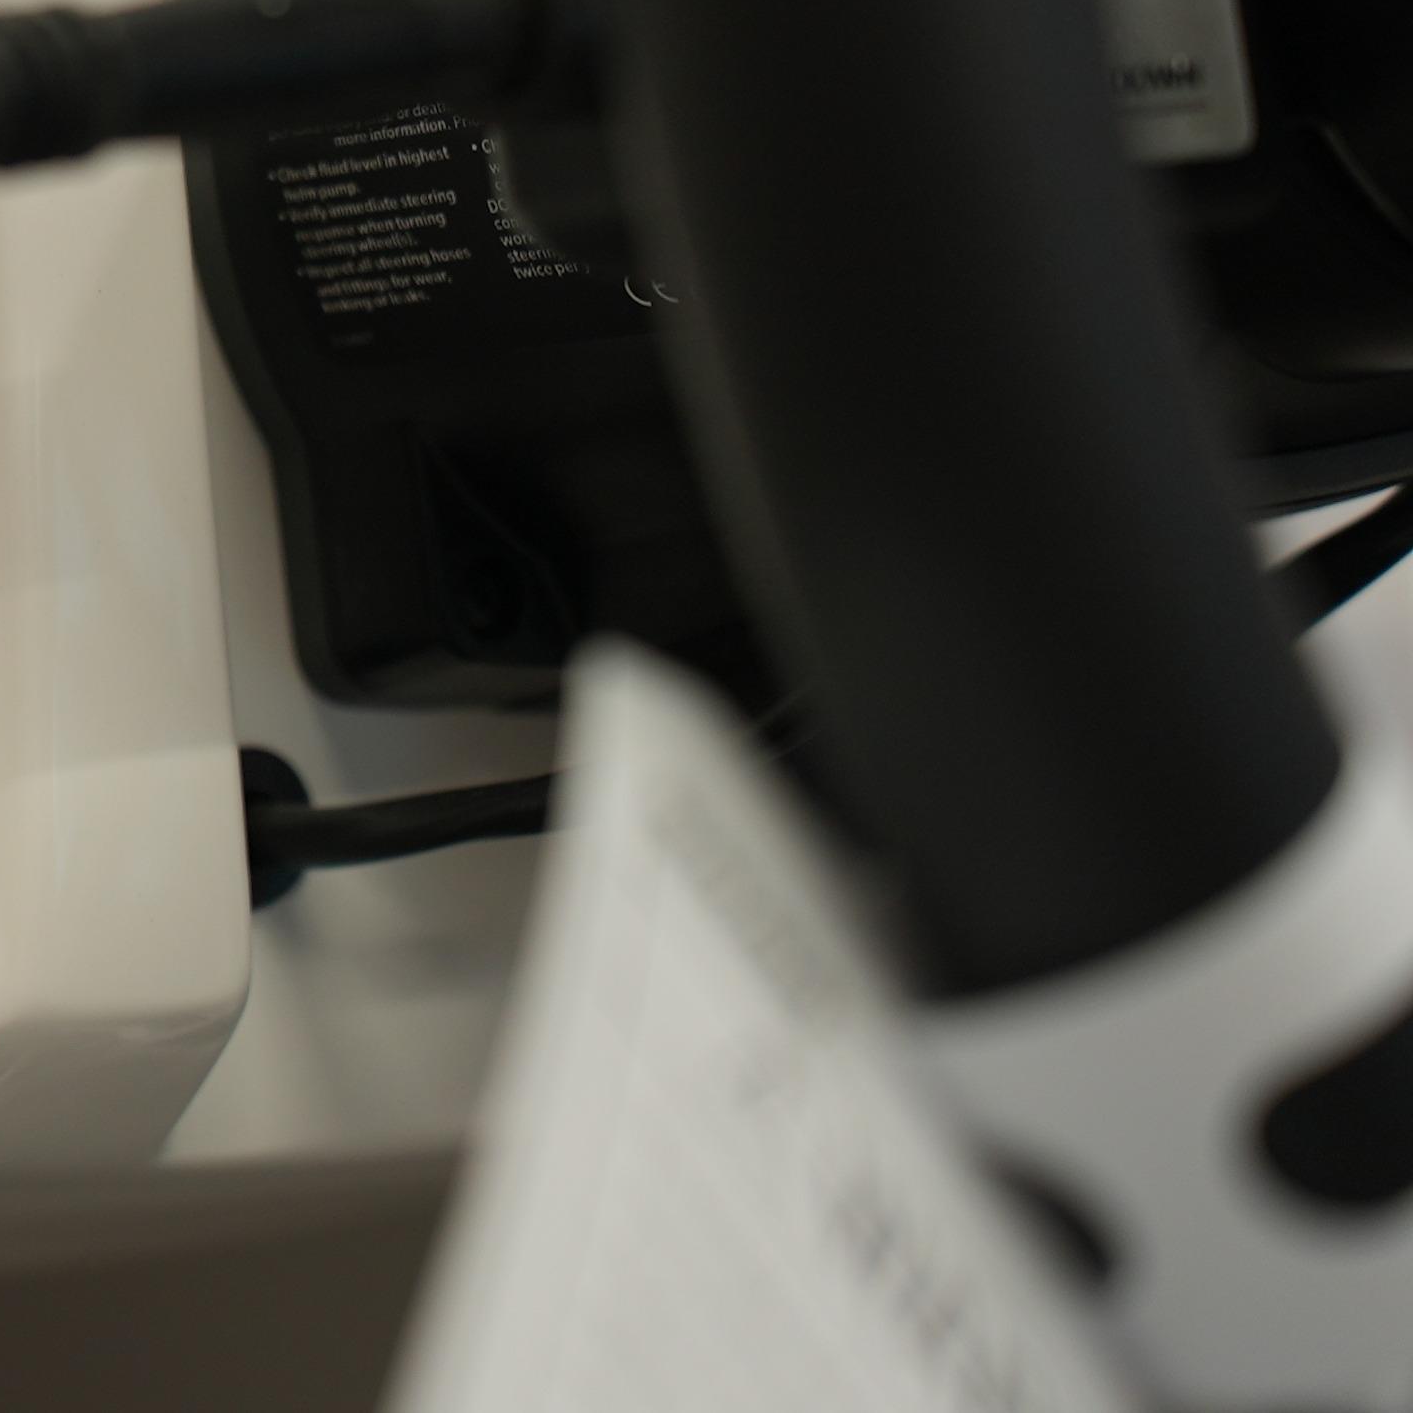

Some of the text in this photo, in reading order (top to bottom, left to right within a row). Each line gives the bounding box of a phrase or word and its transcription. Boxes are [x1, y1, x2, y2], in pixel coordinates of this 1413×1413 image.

[333, 133, 368, 147] more
[369, 118, 451, 142] information.
[350, 154, 383, 173] level
[384, 152, 398, 168] in
[398, 146, 451, 168] highest
[399, 188, 457, 208] steering
[356, 218, 395, 235] when
[395, 211, 447, 230] turning
[429, 247, 471, 263] hoses
[512, 262, 553, 279] twice
